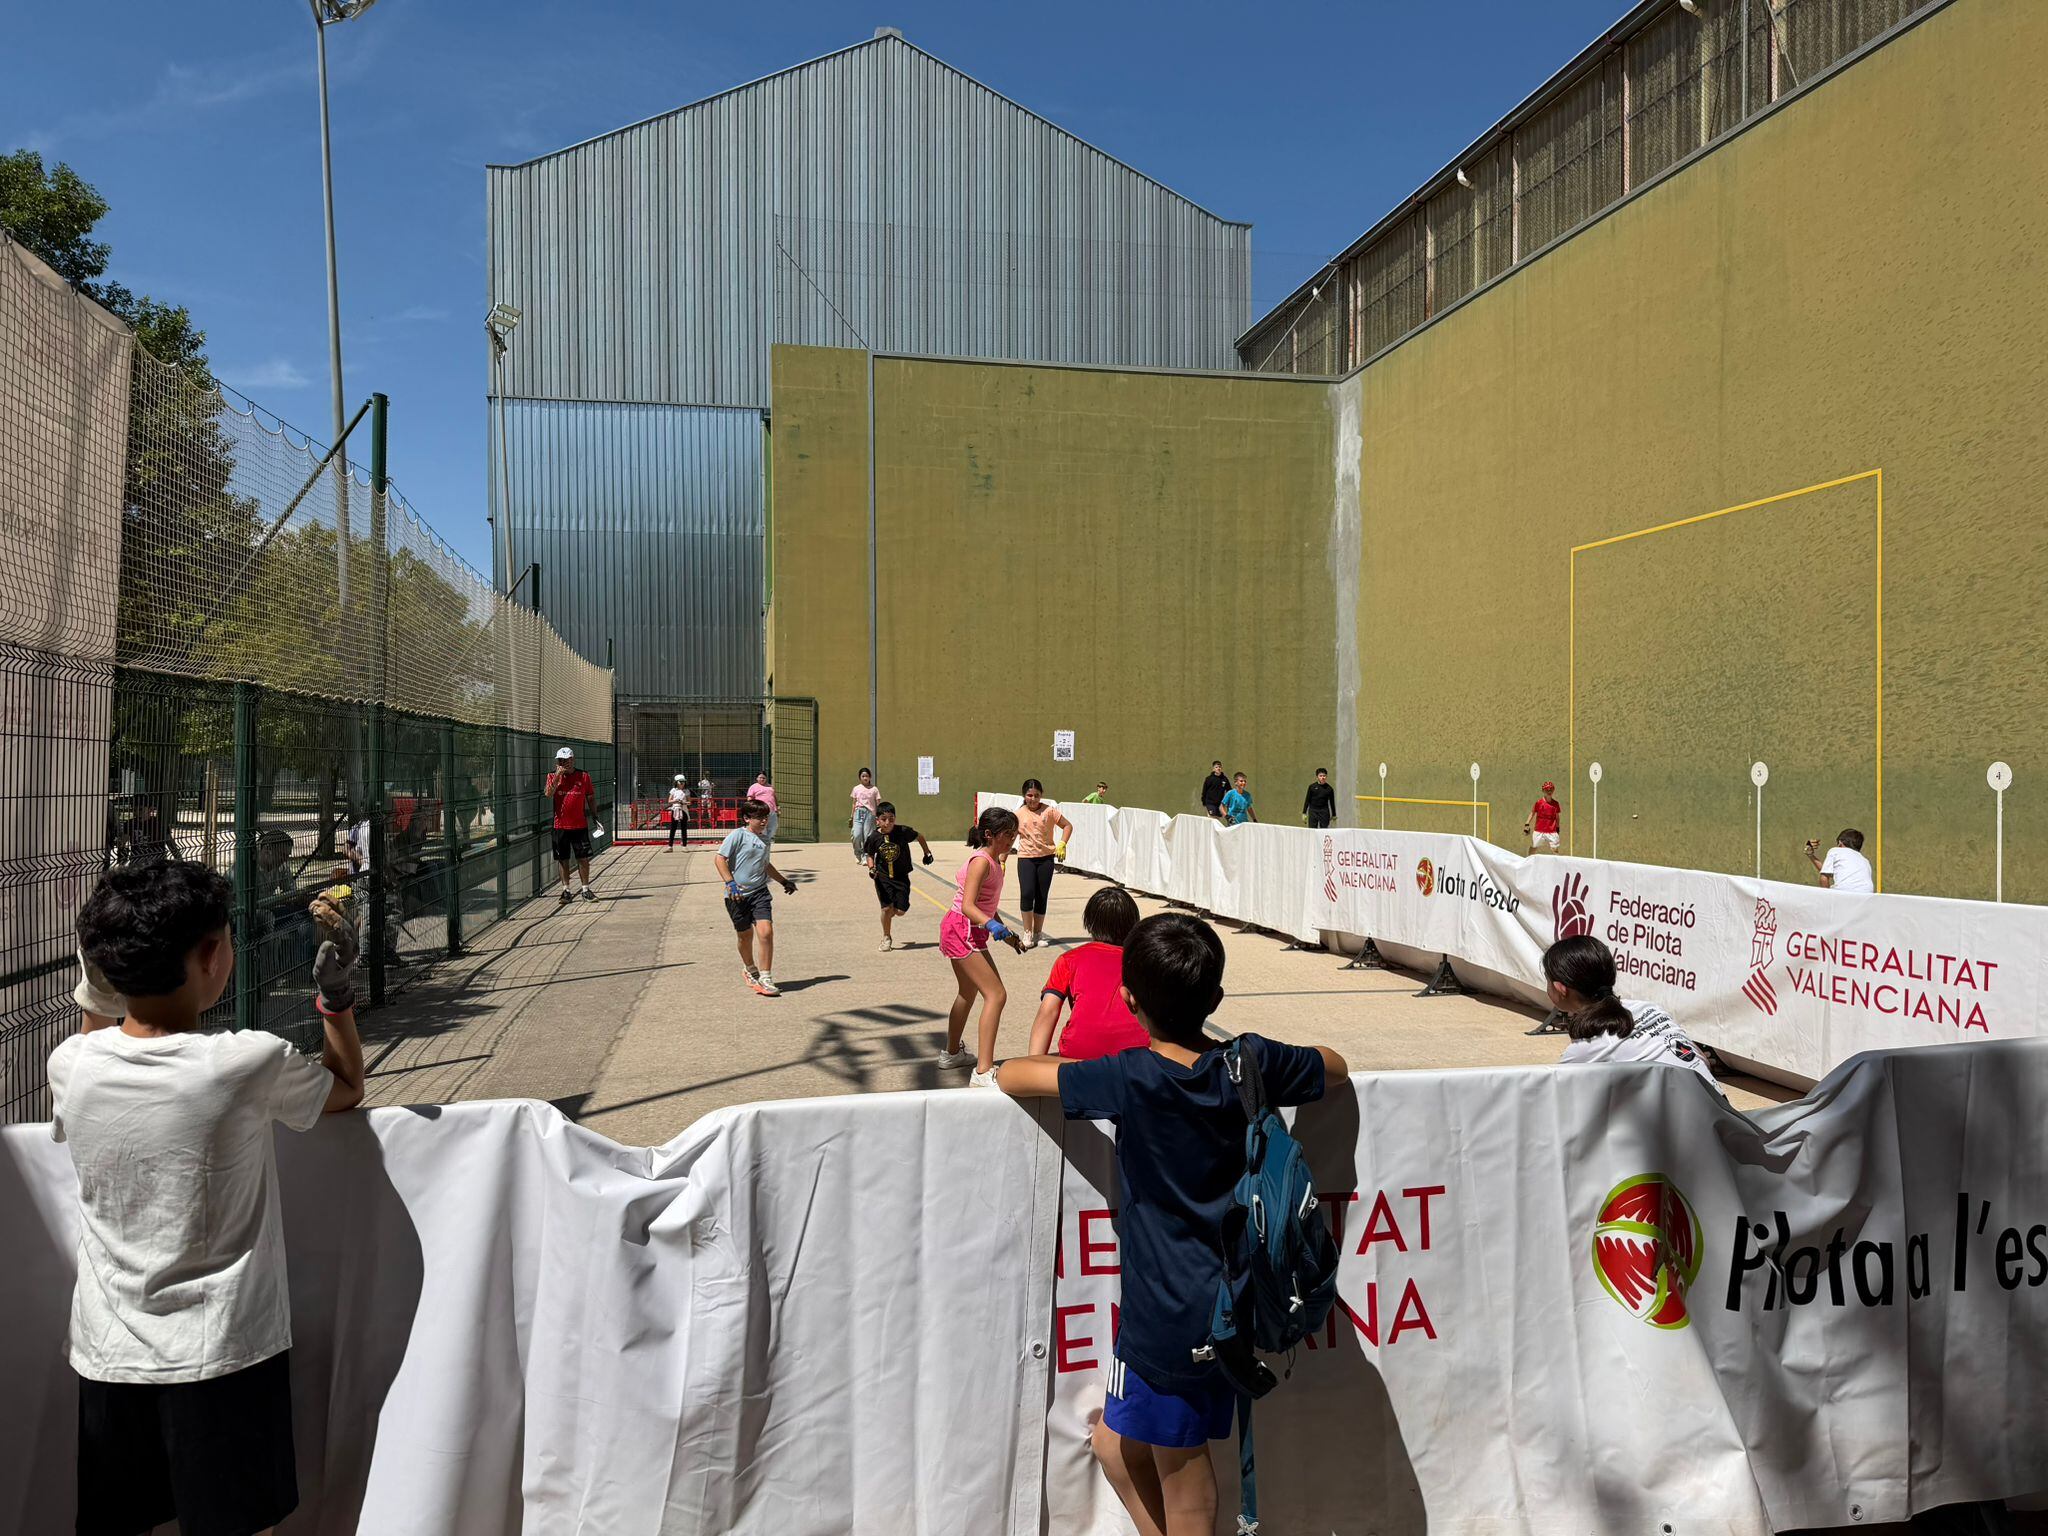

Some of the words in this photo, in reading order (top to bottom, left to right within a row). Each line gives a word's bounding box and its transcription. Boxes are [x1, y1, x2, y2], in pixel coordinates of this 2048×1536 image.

[1337, 850, 1399, 871] GENERALITAT
[1338, 871, 1397, 893] VALENCIANA
[1609, 891, 1696, 928] Federació
[1607, 919, 1629, 943] de
[1633, 924, 1682, 957] Pilota
[1786, 930, 1999, 992] GENERALITAT
[1786, 965, 1990, 1034] VALENCIANA
